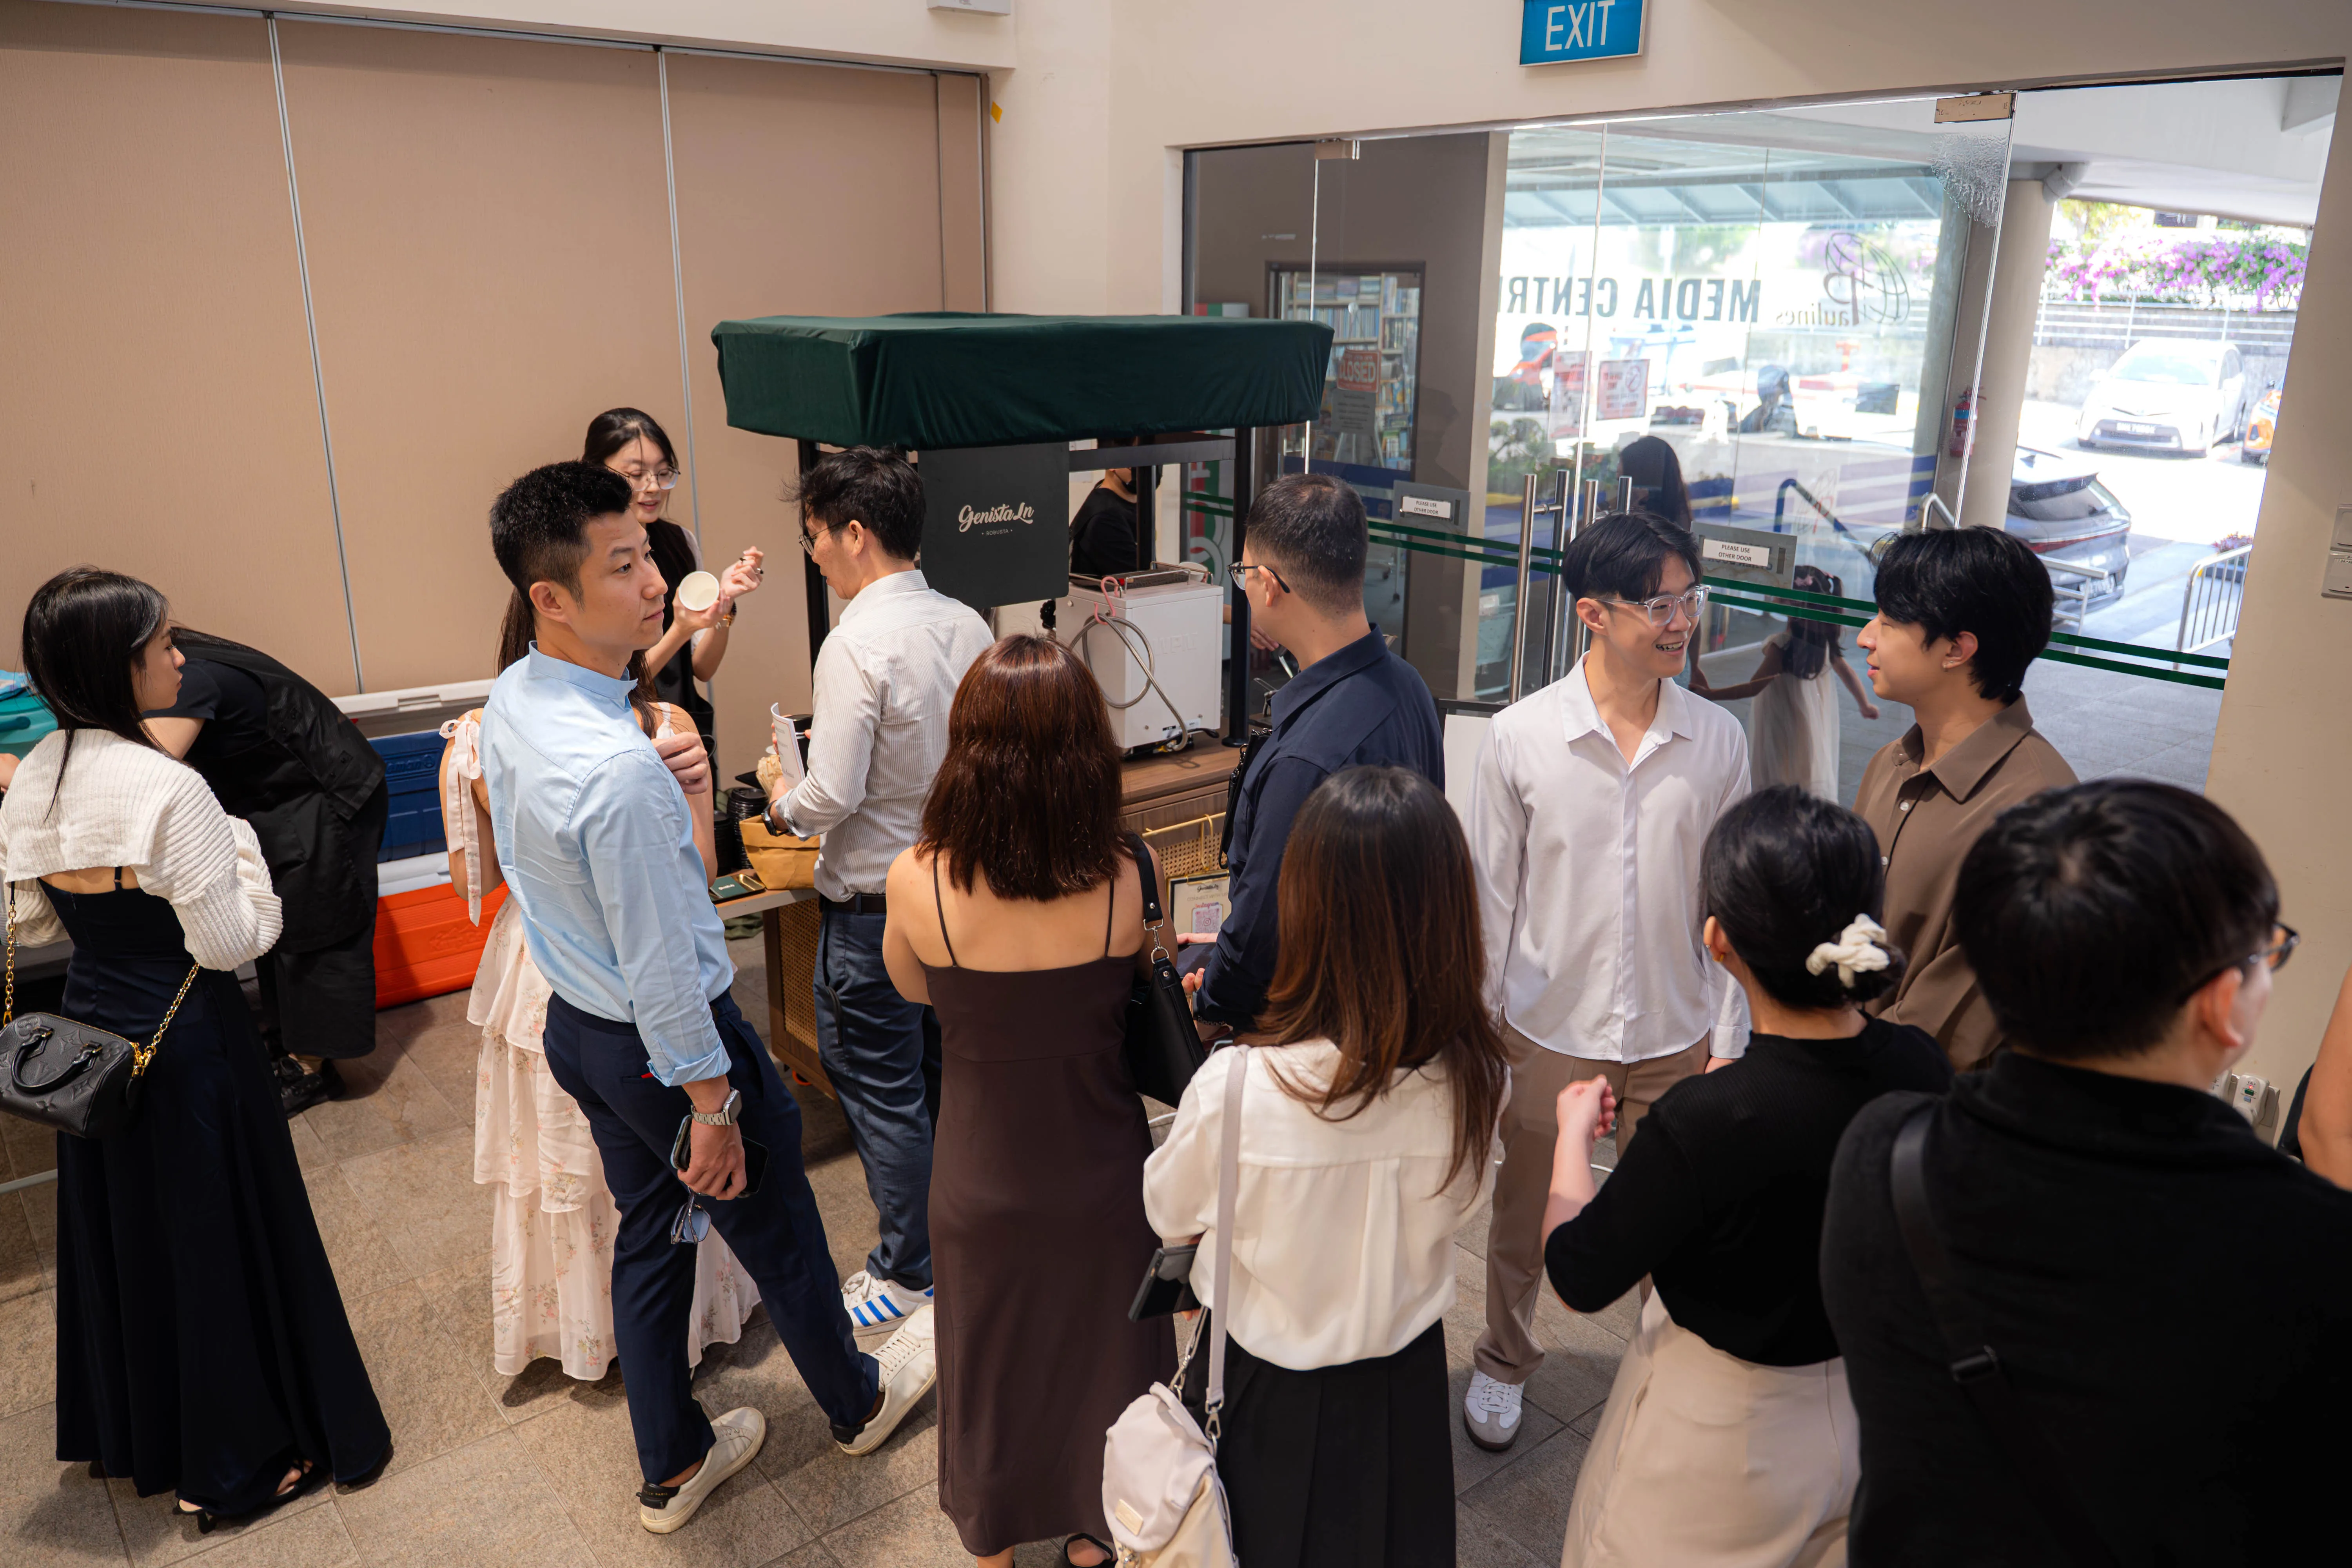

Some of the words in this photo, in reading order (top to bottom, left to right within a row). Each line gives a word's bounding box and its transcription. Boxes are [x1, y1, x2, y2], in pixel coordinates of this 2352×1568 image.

[1545, 0, 1615, 51] EXIT
[959, 503, 1014, 532] Genista
[1013, 502, 1034, 524] Ln
